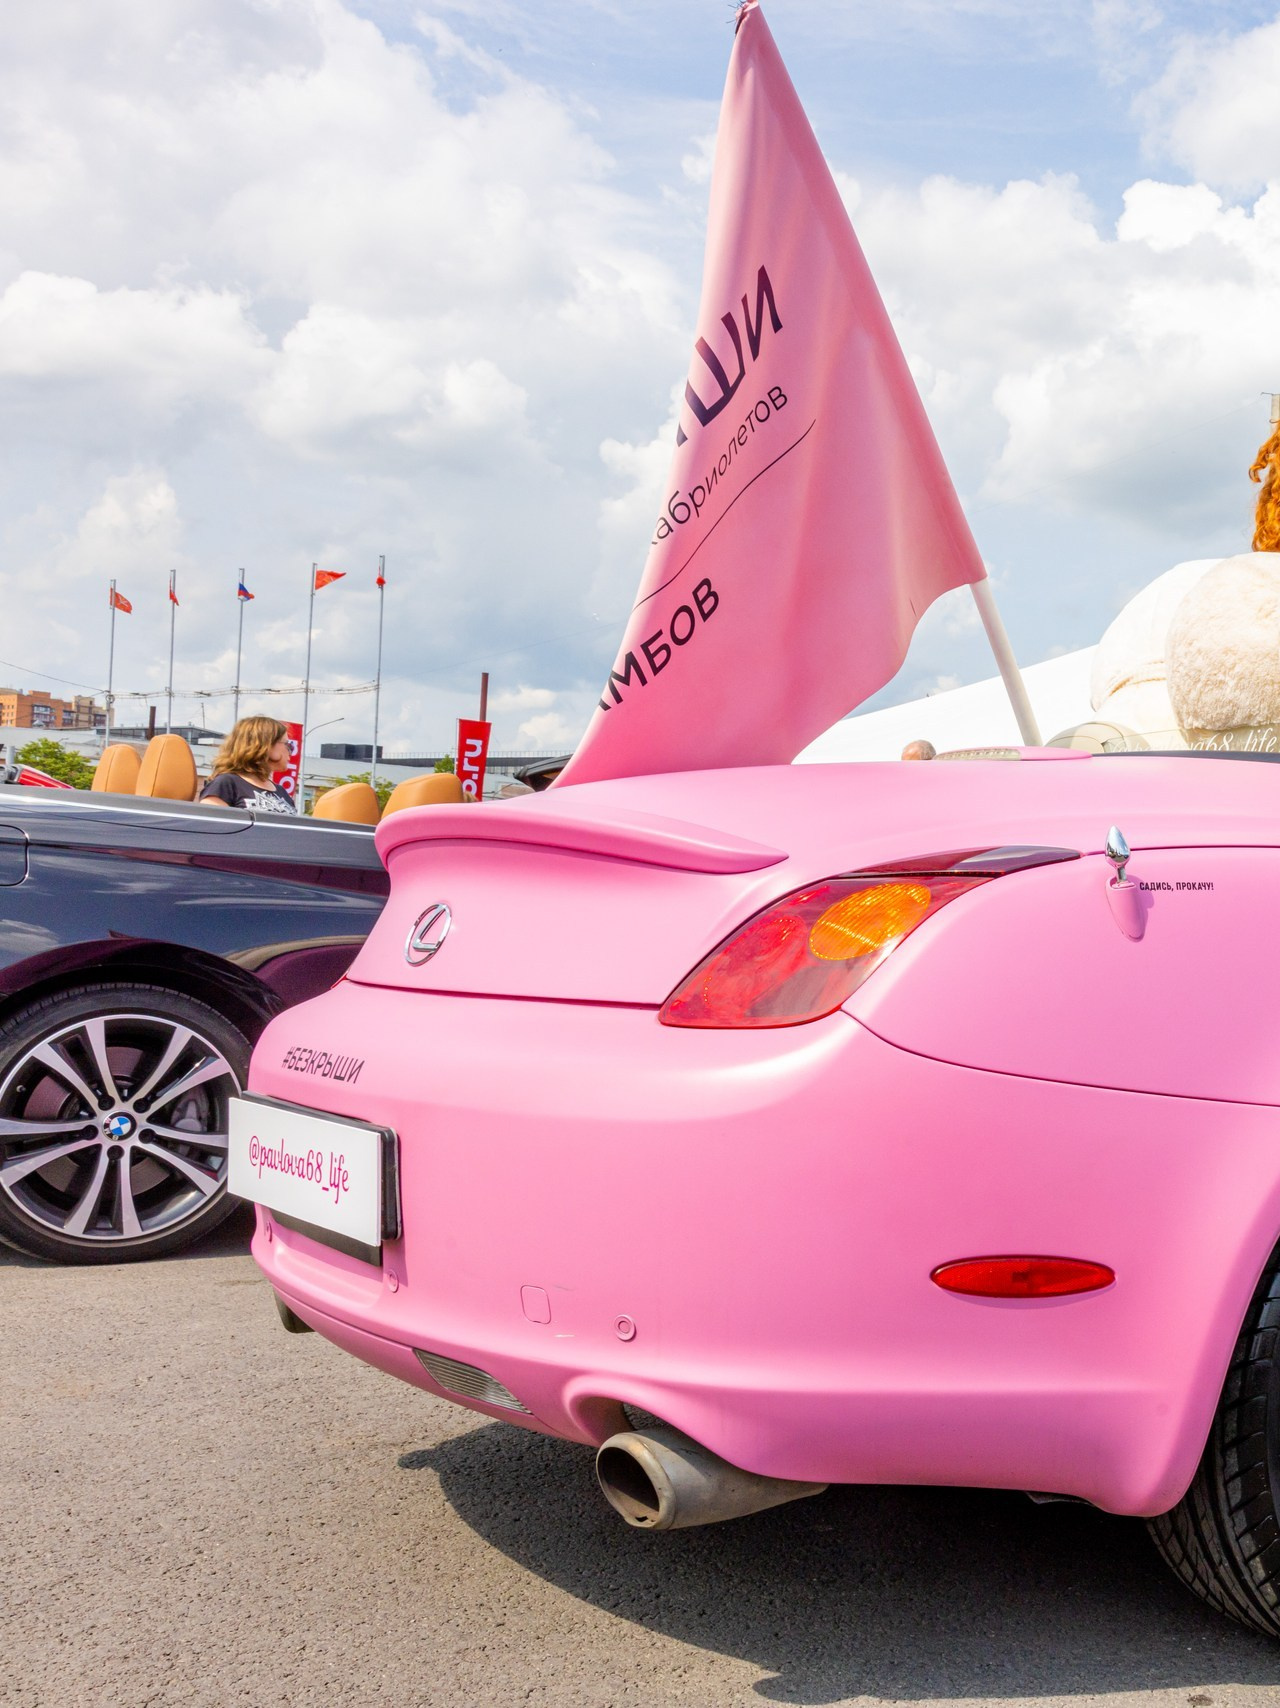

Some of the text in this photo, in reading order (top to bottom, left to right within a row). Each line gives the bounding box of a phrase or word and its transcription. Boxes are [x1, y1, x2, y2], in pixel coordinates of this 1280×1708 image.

[676, 264, 783, 447] ШИ
[651, 386, 788, 545] абриолетов
[1139, 881, 1214, 892] САДИСЬ, ПРОКАЧУ!
[281, 1046, 365, 1084] #БЕЗКРЫШИ
[249, 1135, 350, 1204] @pavlova68_life
